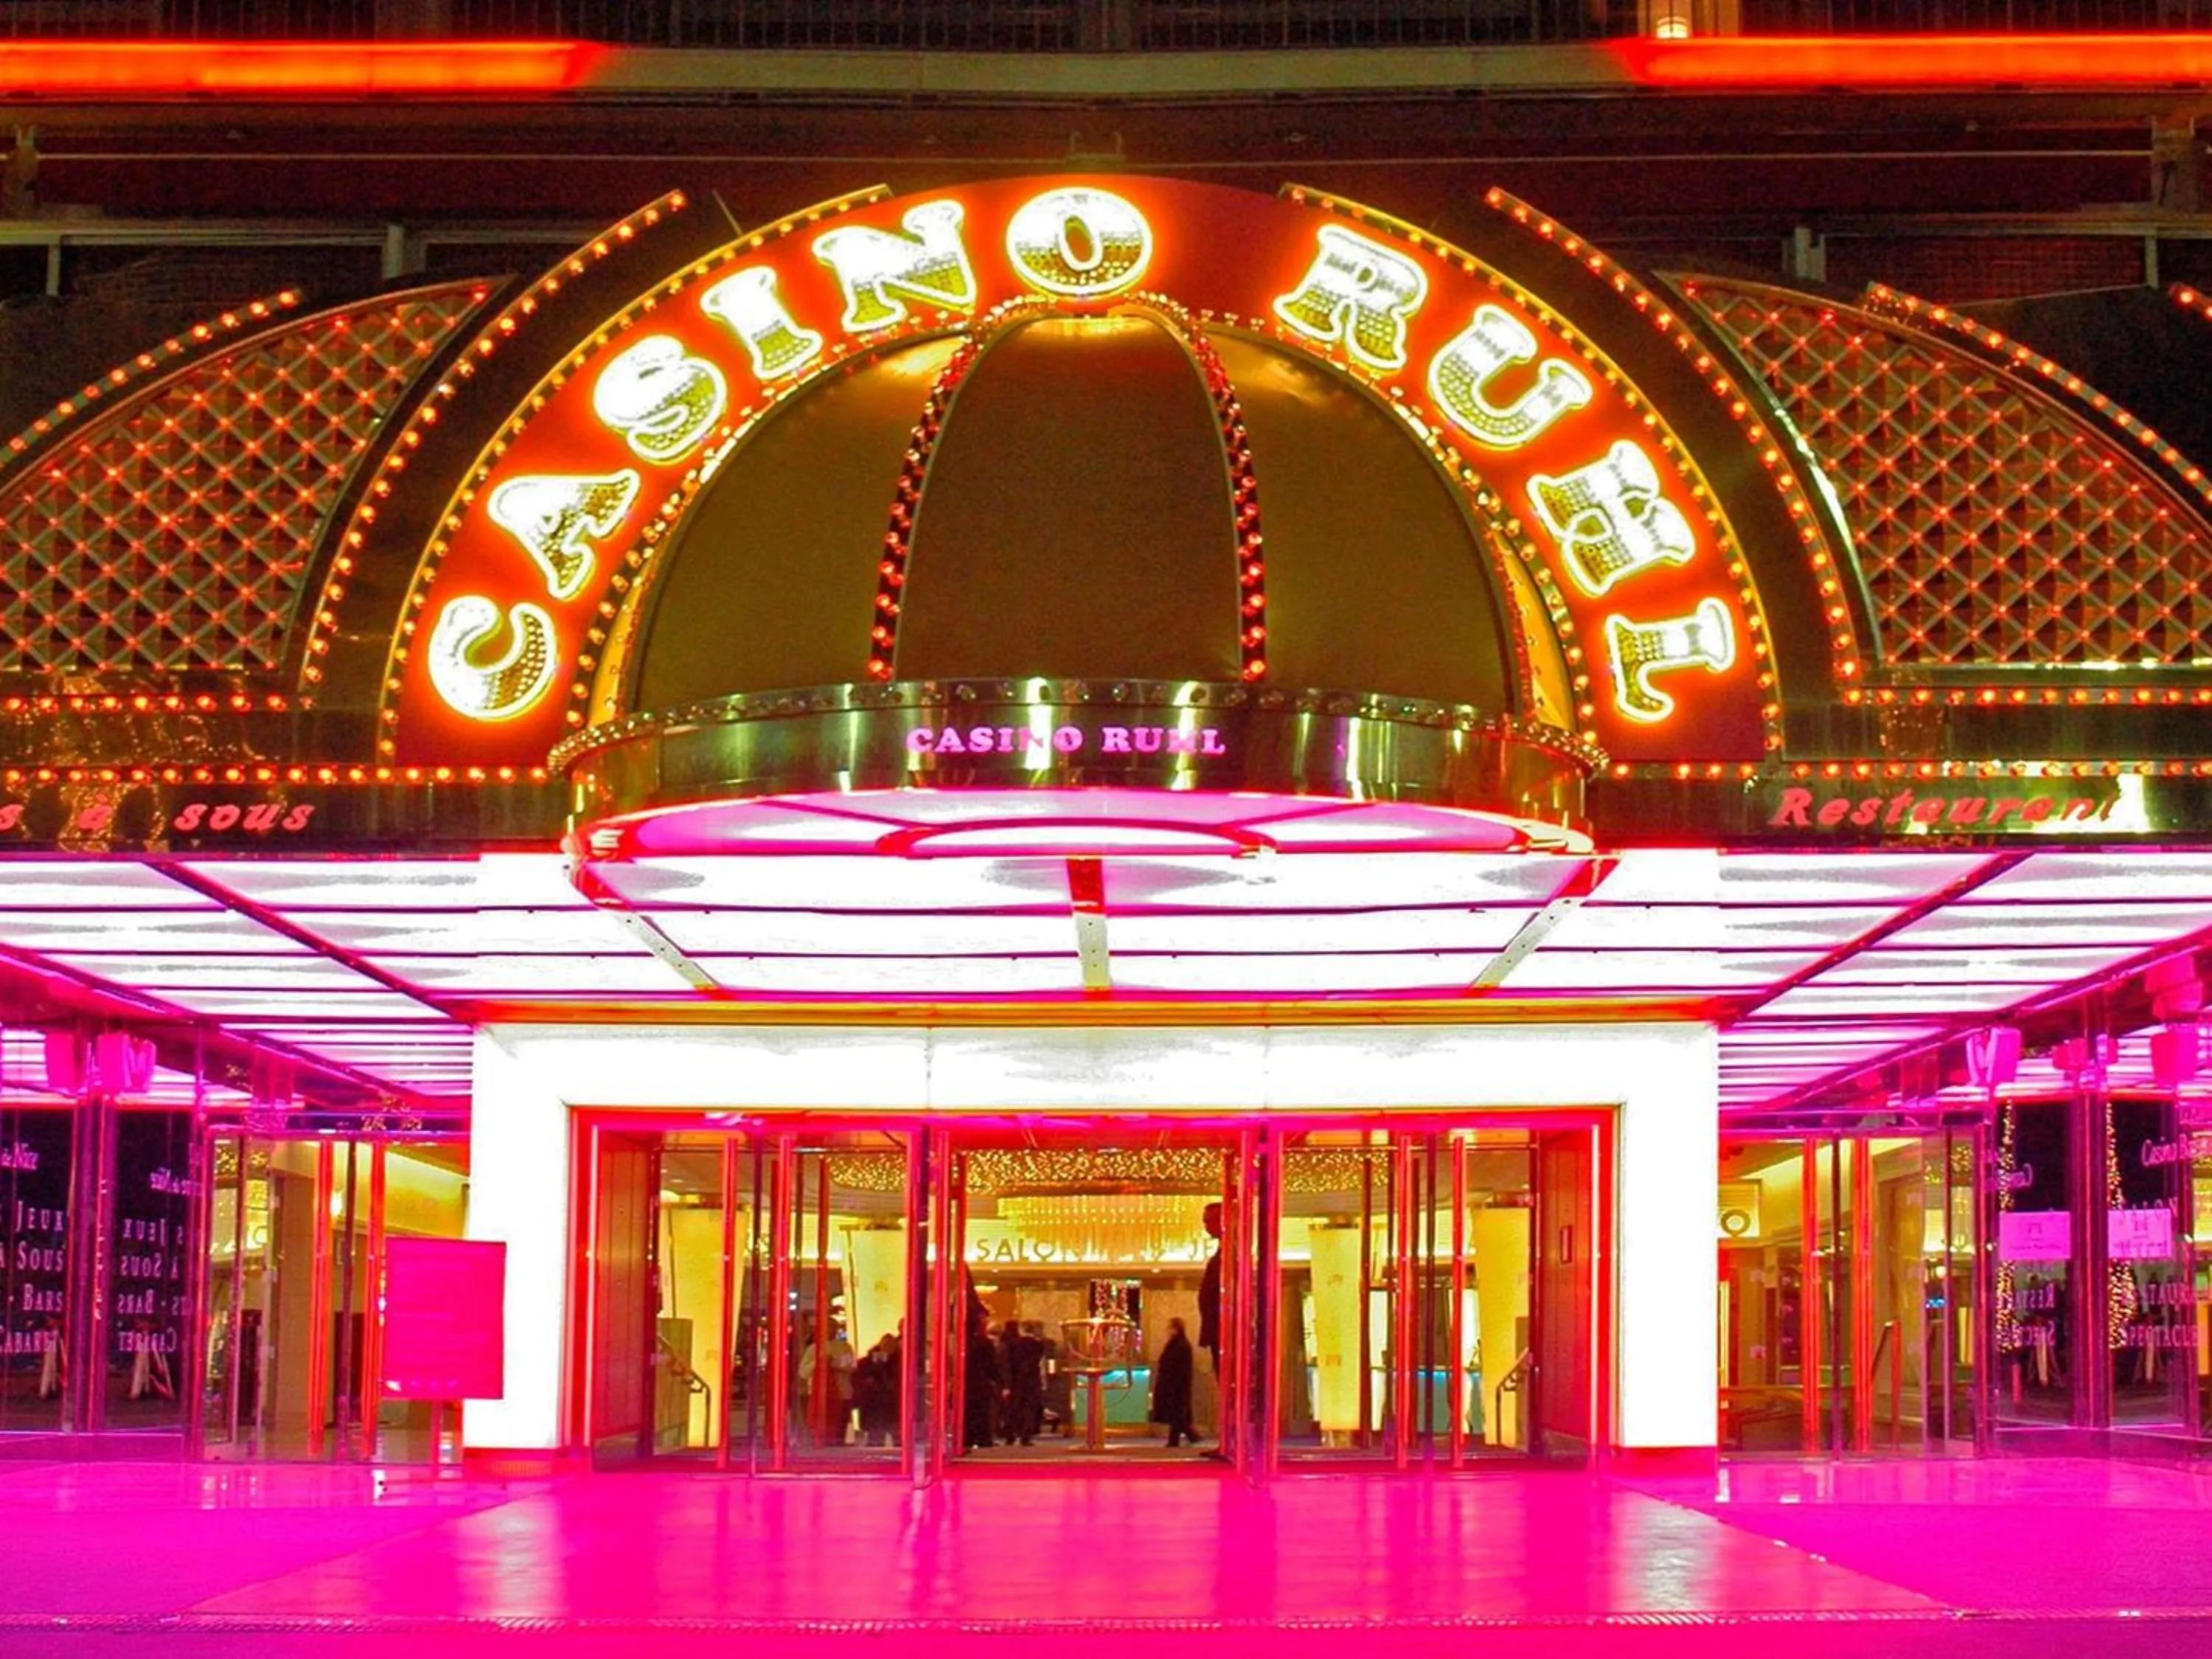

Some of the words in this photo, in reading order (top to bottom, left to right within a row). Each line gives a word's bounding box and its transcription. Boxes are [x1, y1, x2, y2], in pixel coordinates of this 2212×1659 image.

[428, 187, 1152, 720] CASINO
[1273, 224, 1735, 722] RUHL
[906, 726, 1083, 753] CASINO
[1102, 726, 1226, 754] RUHL
[175, 803, 315, 831] sous
[1768, 787, 2121, 827] Restaurant
